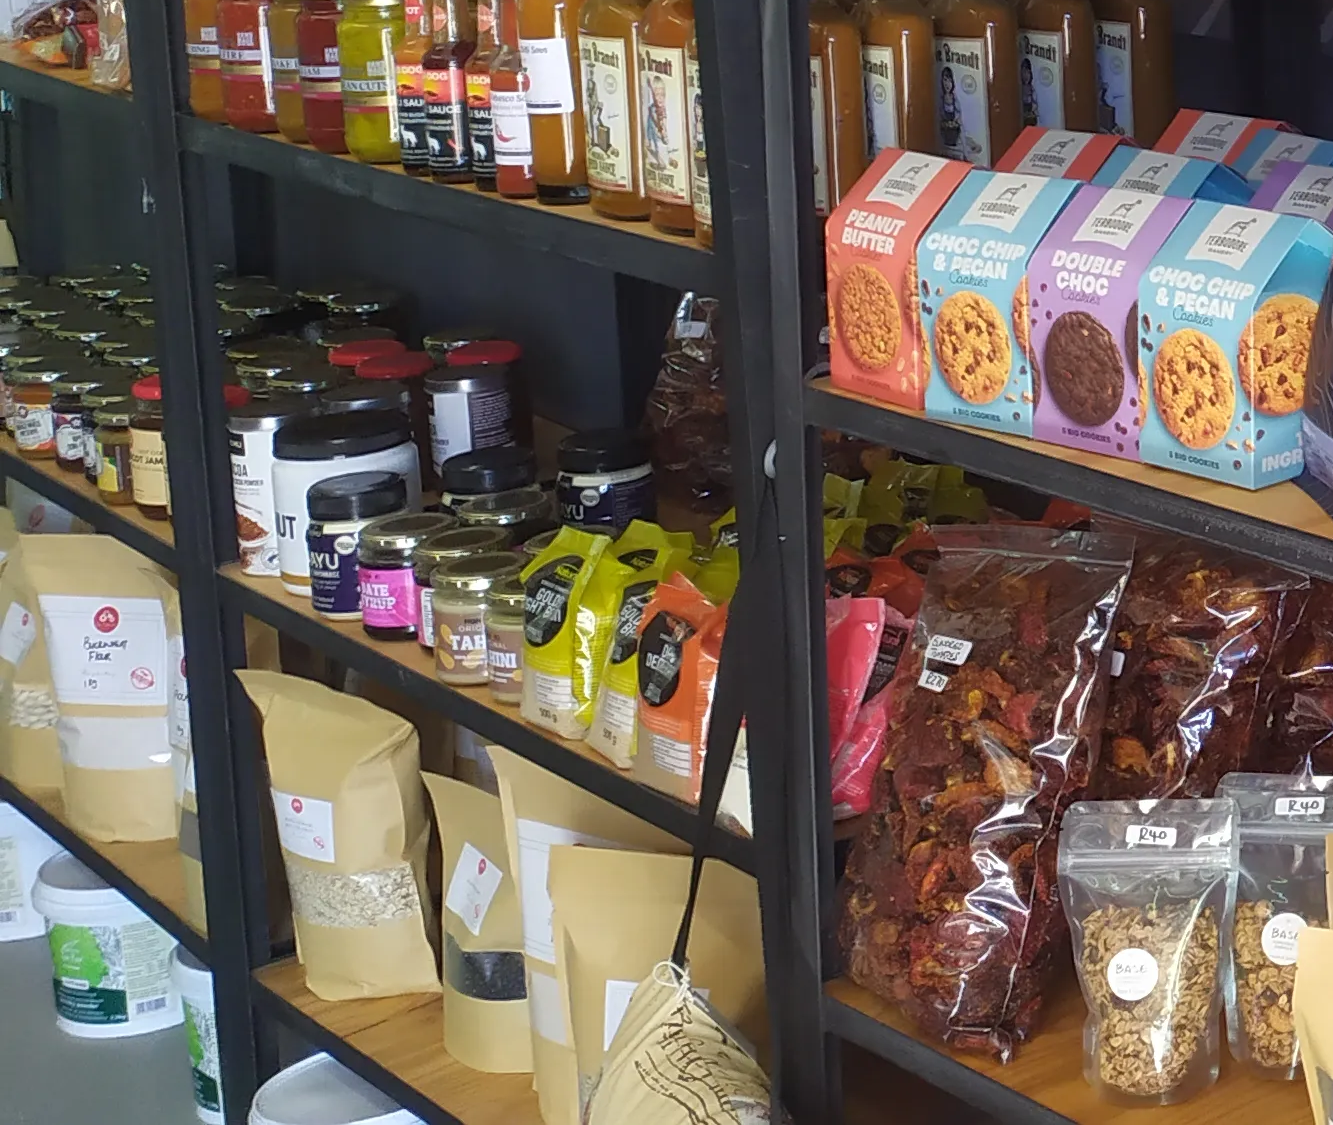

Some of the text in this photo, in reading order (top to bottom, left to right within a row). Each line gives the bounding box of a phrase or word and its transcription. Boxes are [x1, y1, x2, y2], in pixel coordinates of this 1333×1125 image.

[592, 42, 620, 69] Brandt
[944, 44, 980, 72] Brandt
[1023, 37, 1057, 65] Brandt
[428, 105, 461, 113] SAUCE
[845, 208, 906, 233] PEANUT
[842, 227, 895, 256] BUTTER
[926, 233, 1027, 261] CHOC CHIP
[933, 254, 1009, 280] & PECAN
[1051, 249, 1128, 278] DOUBLE
[950, 268, 989, 288] Cookies
[1055, 270, 1109, 297] CHOC
[1149, 264, 1256, 301] CHOC CHIP
[1155, 286, 1236, 320] & PECAN
[1171, 304, 1214, 327] Cookies
[973, 411, 1001, 423] COOKIES
[1080, 430, 1112, 443] COOKIES
[1175, 451, 1187, 461] BIG
[1188, 455, 1220, 470] COOKIES
[1288, 800, 1319, 812] R40
[1138, 828, 1167, 842] R40
[1115, 963, 1147, 974] BASE
